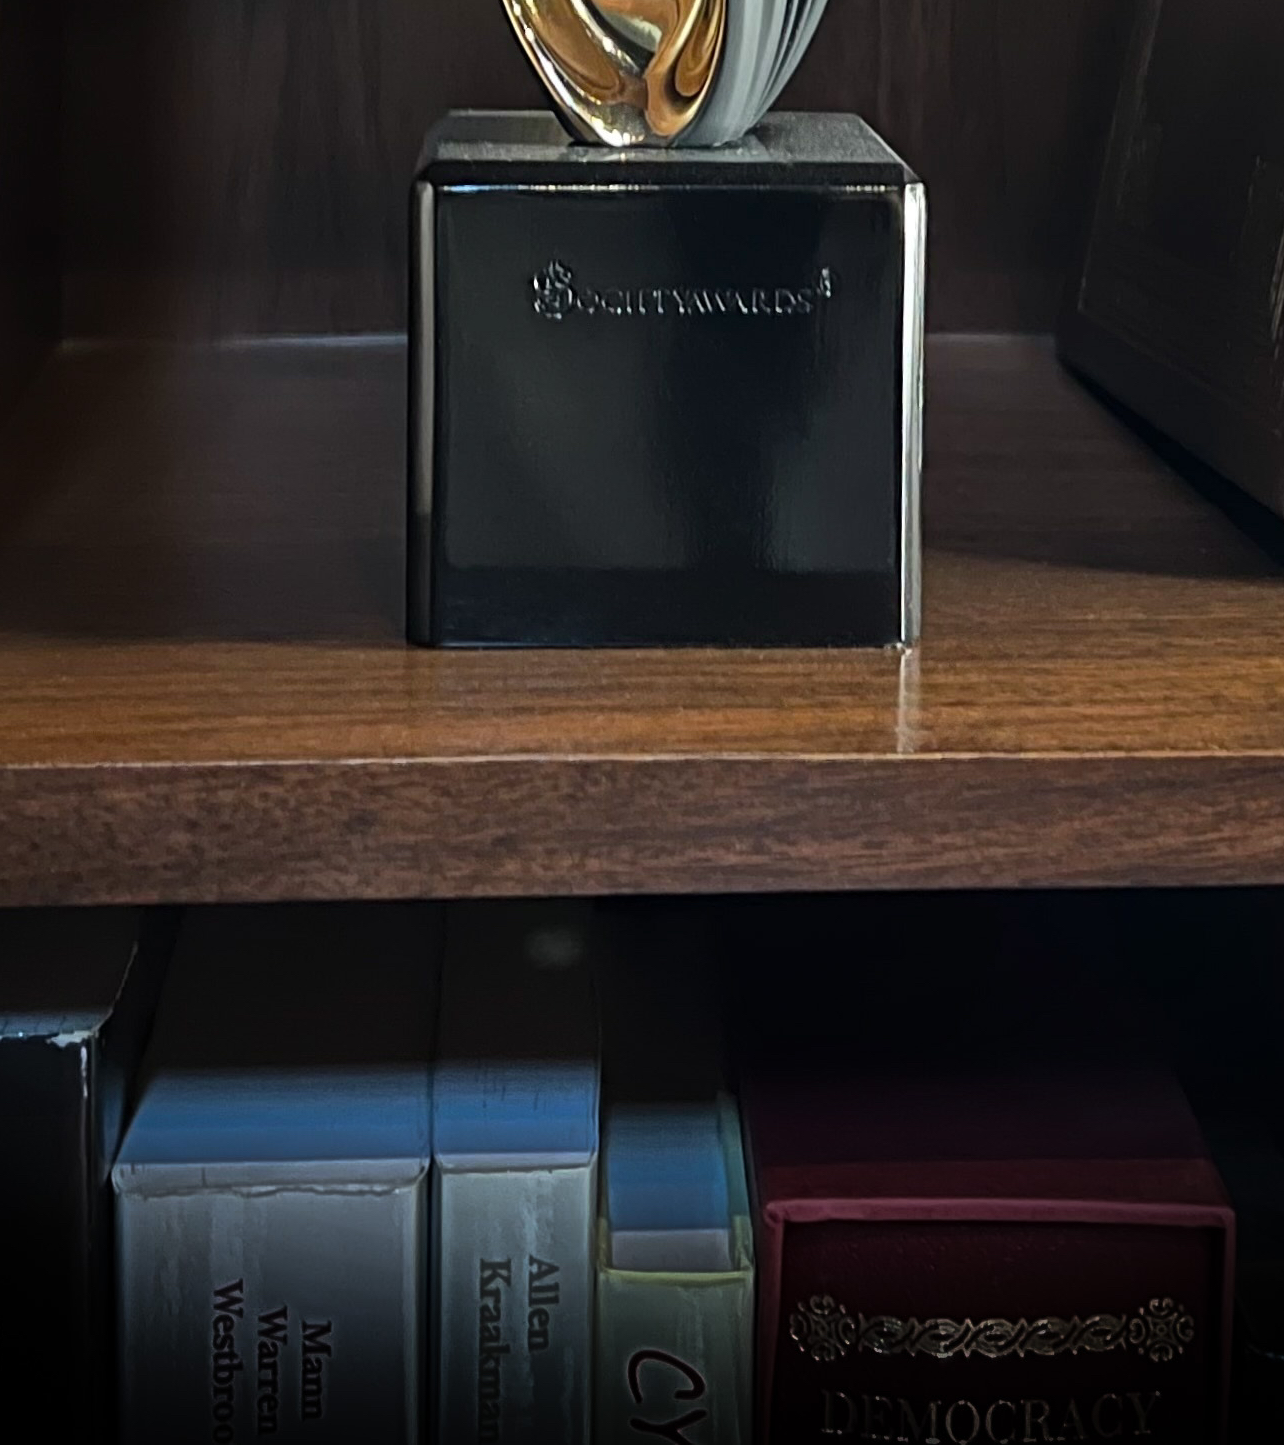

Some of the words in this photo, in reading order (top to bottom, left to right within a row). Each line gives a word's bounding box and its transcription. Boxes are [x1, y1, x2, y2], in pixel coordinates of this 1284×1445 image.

[213, 1278, 245, 1445] Westbroo
[477, 1257, 512, 1444] Kraakman
[527, 1254, 560, 1353] Allen
[257, 1305, 288, 1436] Warren
[301, 1320, 332, 1423] Mann
[819, 1387, 1161, 1445] DEMOCRACY
